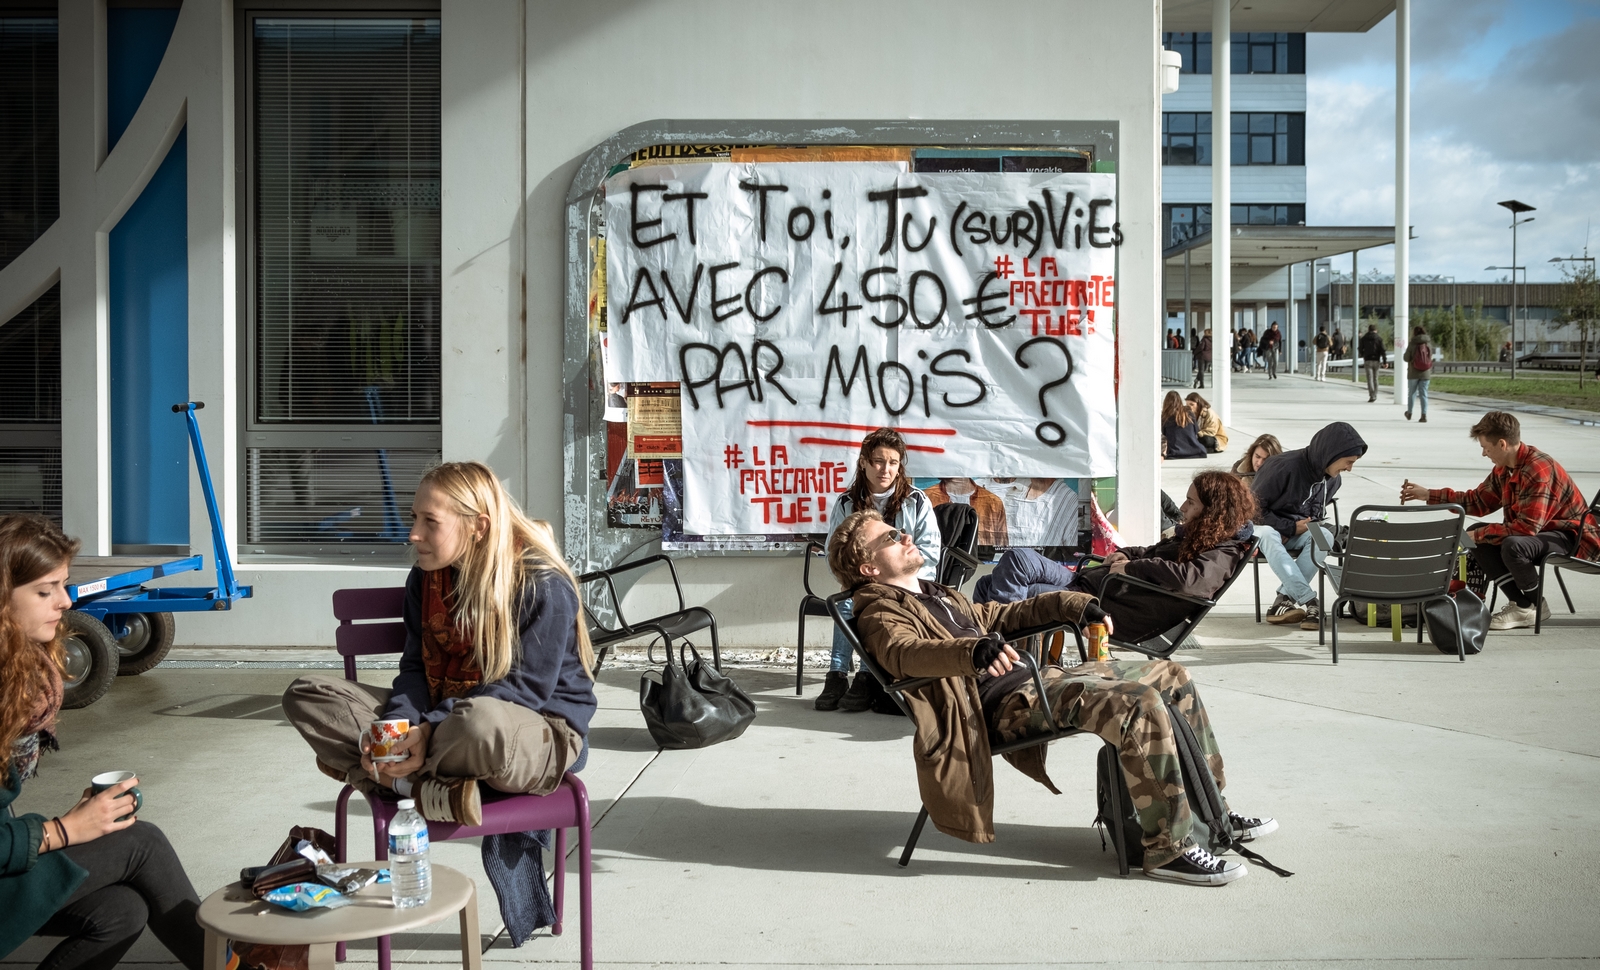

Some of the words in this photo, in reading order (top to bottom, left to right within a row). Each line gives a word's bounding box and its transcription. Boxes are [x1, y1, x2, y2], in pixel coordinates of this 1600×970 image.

[629, 182, 708, 249] ET
[622, 263, 788, 325] AVEC
[818, 262, 947, 329] 450
[962, 271, 1017, 329] €
[679, 339, 798, 410] PAR
[1015, 336, 1074, 447] ?
